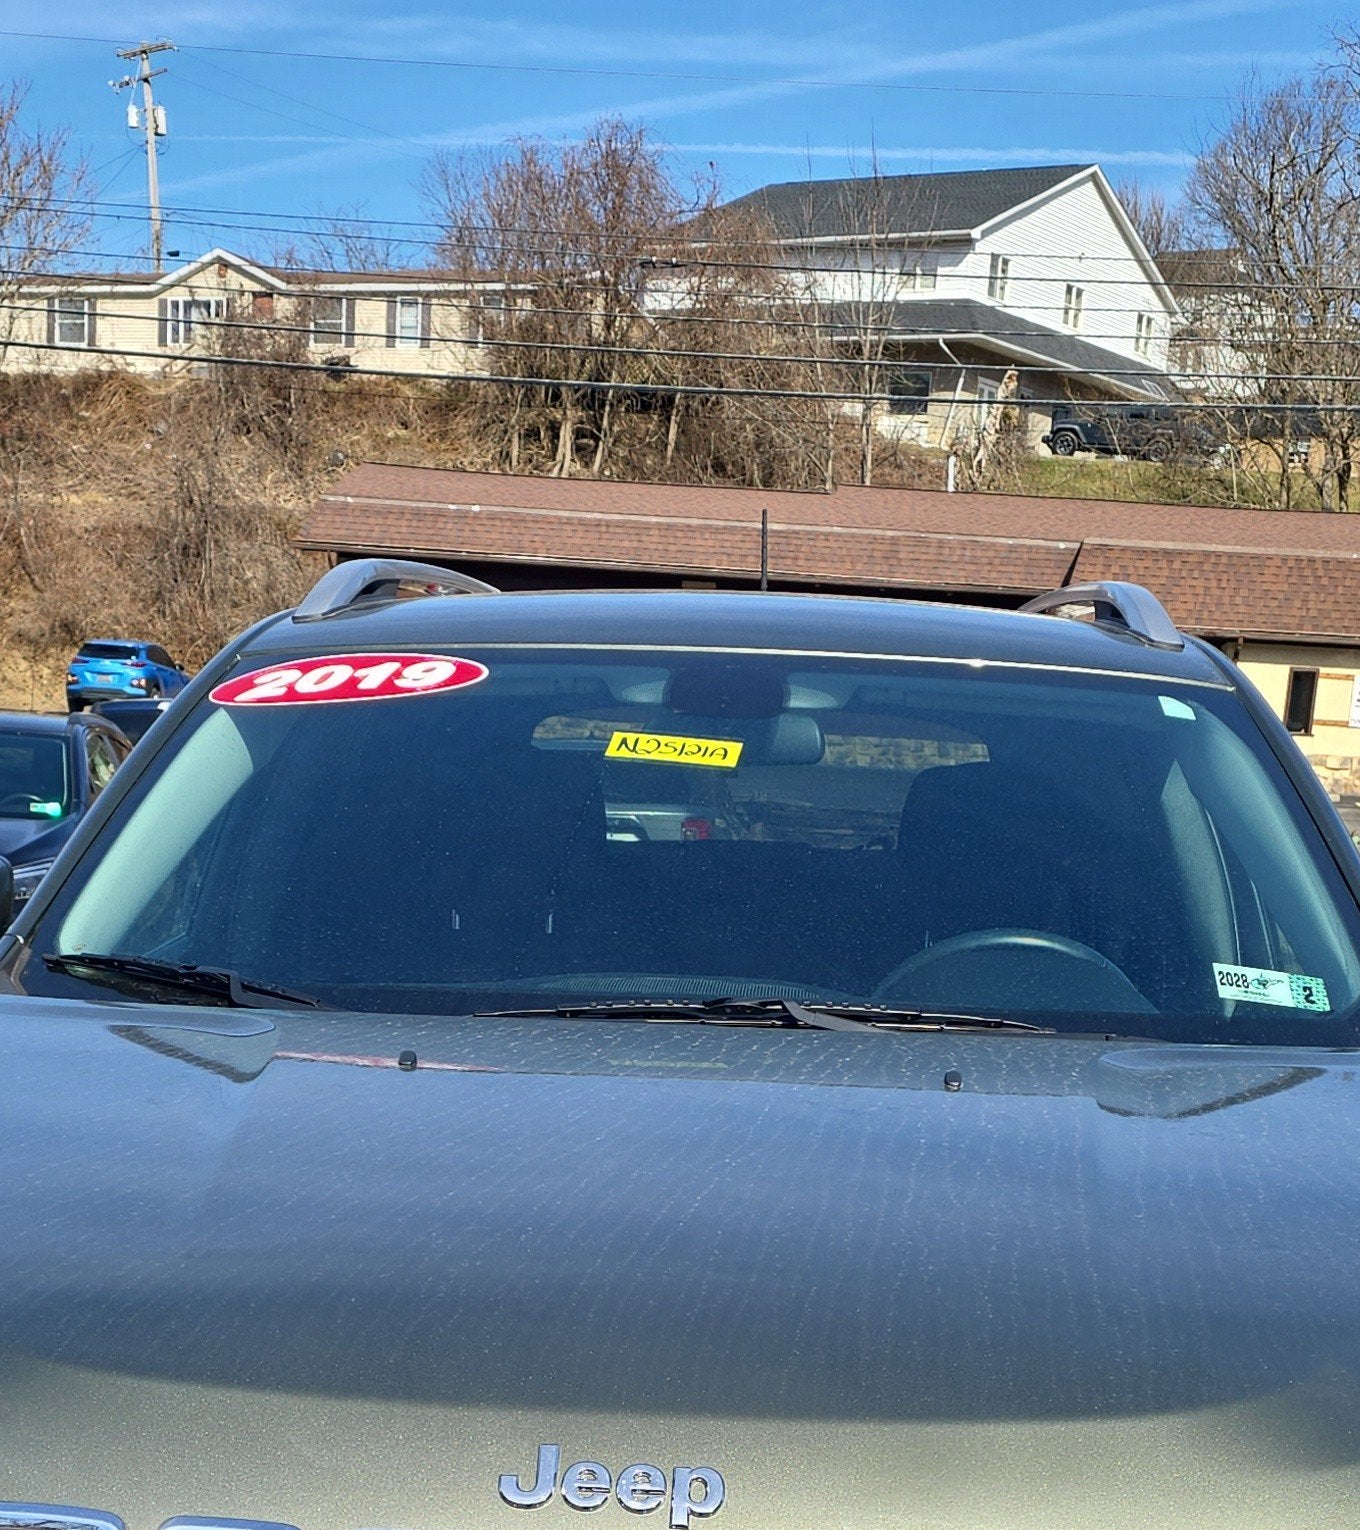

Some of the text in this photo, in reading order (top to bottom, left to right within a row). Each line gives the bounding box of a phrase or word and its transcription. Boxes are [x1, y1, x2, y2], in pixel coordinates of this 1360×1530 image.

[233, 659, 457, 703] 2019
[1218, 970, 1250, 989] 2028
[1301, 985, 1316, 1005] 2
[498, 1443, 726, 1530] Jeep
